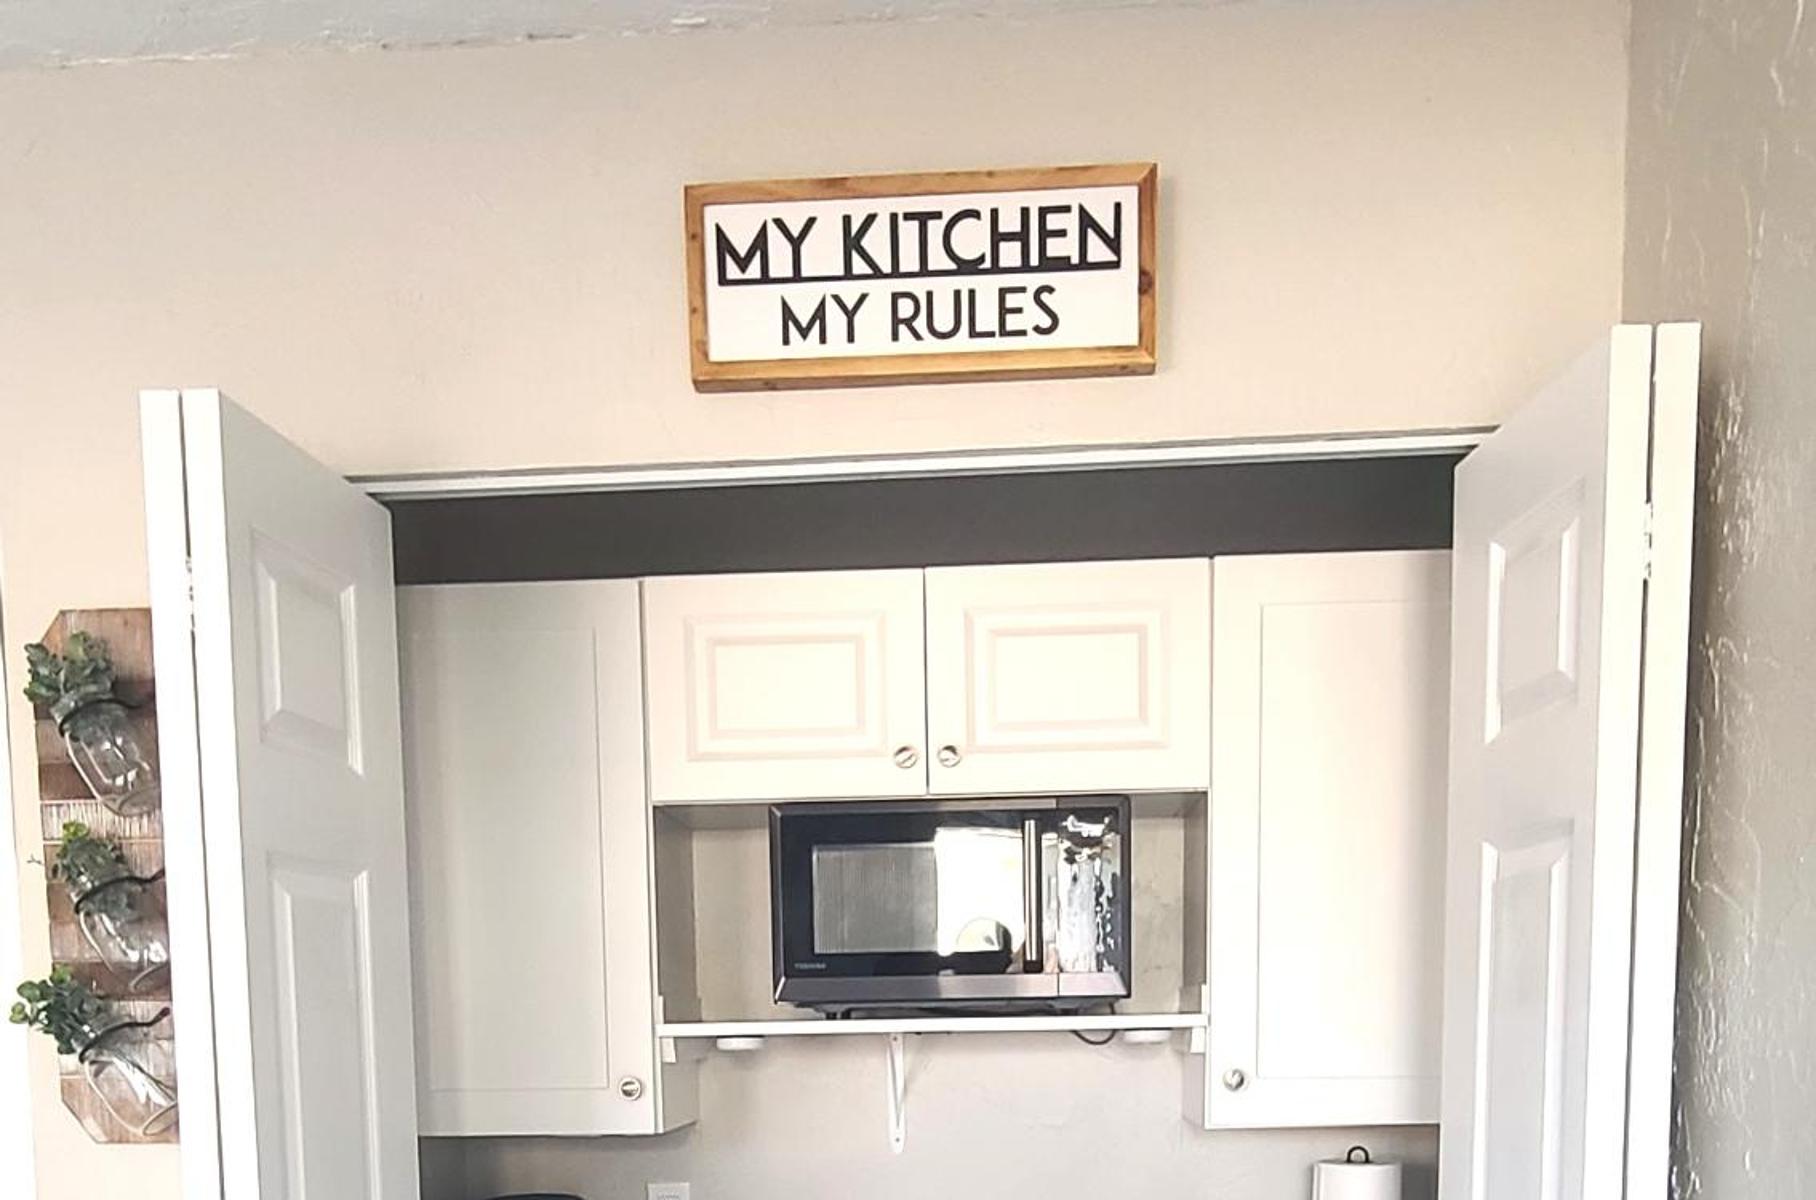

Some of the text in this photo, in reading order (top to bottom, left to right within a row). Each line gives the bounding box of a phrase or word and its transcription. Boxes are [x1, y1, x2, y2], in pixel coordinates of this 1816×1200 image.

[715, 202, 1122, 286] MY KITCHEN
[780, 284, 1060, 346] MY RULES
